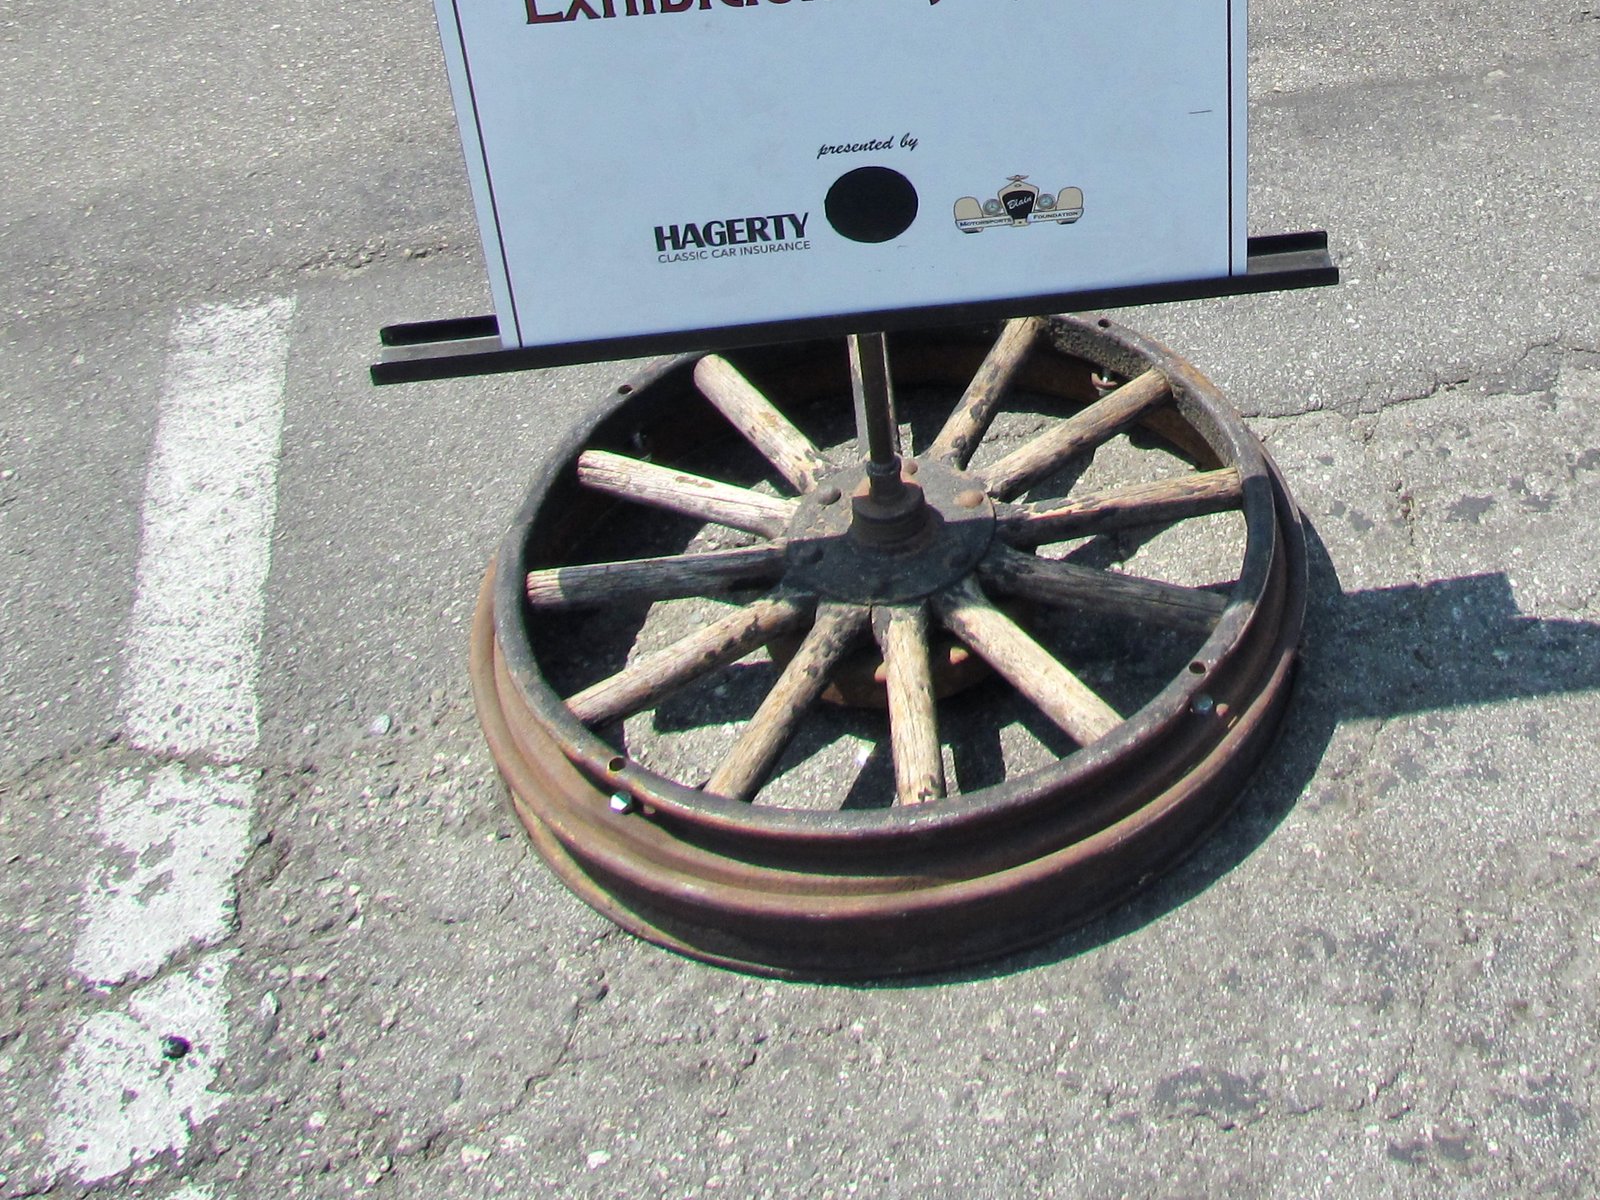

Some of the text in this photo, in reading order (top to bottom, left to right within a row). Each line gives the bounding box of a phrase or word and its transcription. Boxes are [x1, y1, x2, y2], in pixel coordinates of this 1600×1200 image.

[816, 132, 919, 160] presented by
[1033, 211, 1079, 220] FOUNDATION
[654, 212, 809, 251] HAGERTY
[658, 240, 811, 264] CLASSIC CAR INSURANCE
